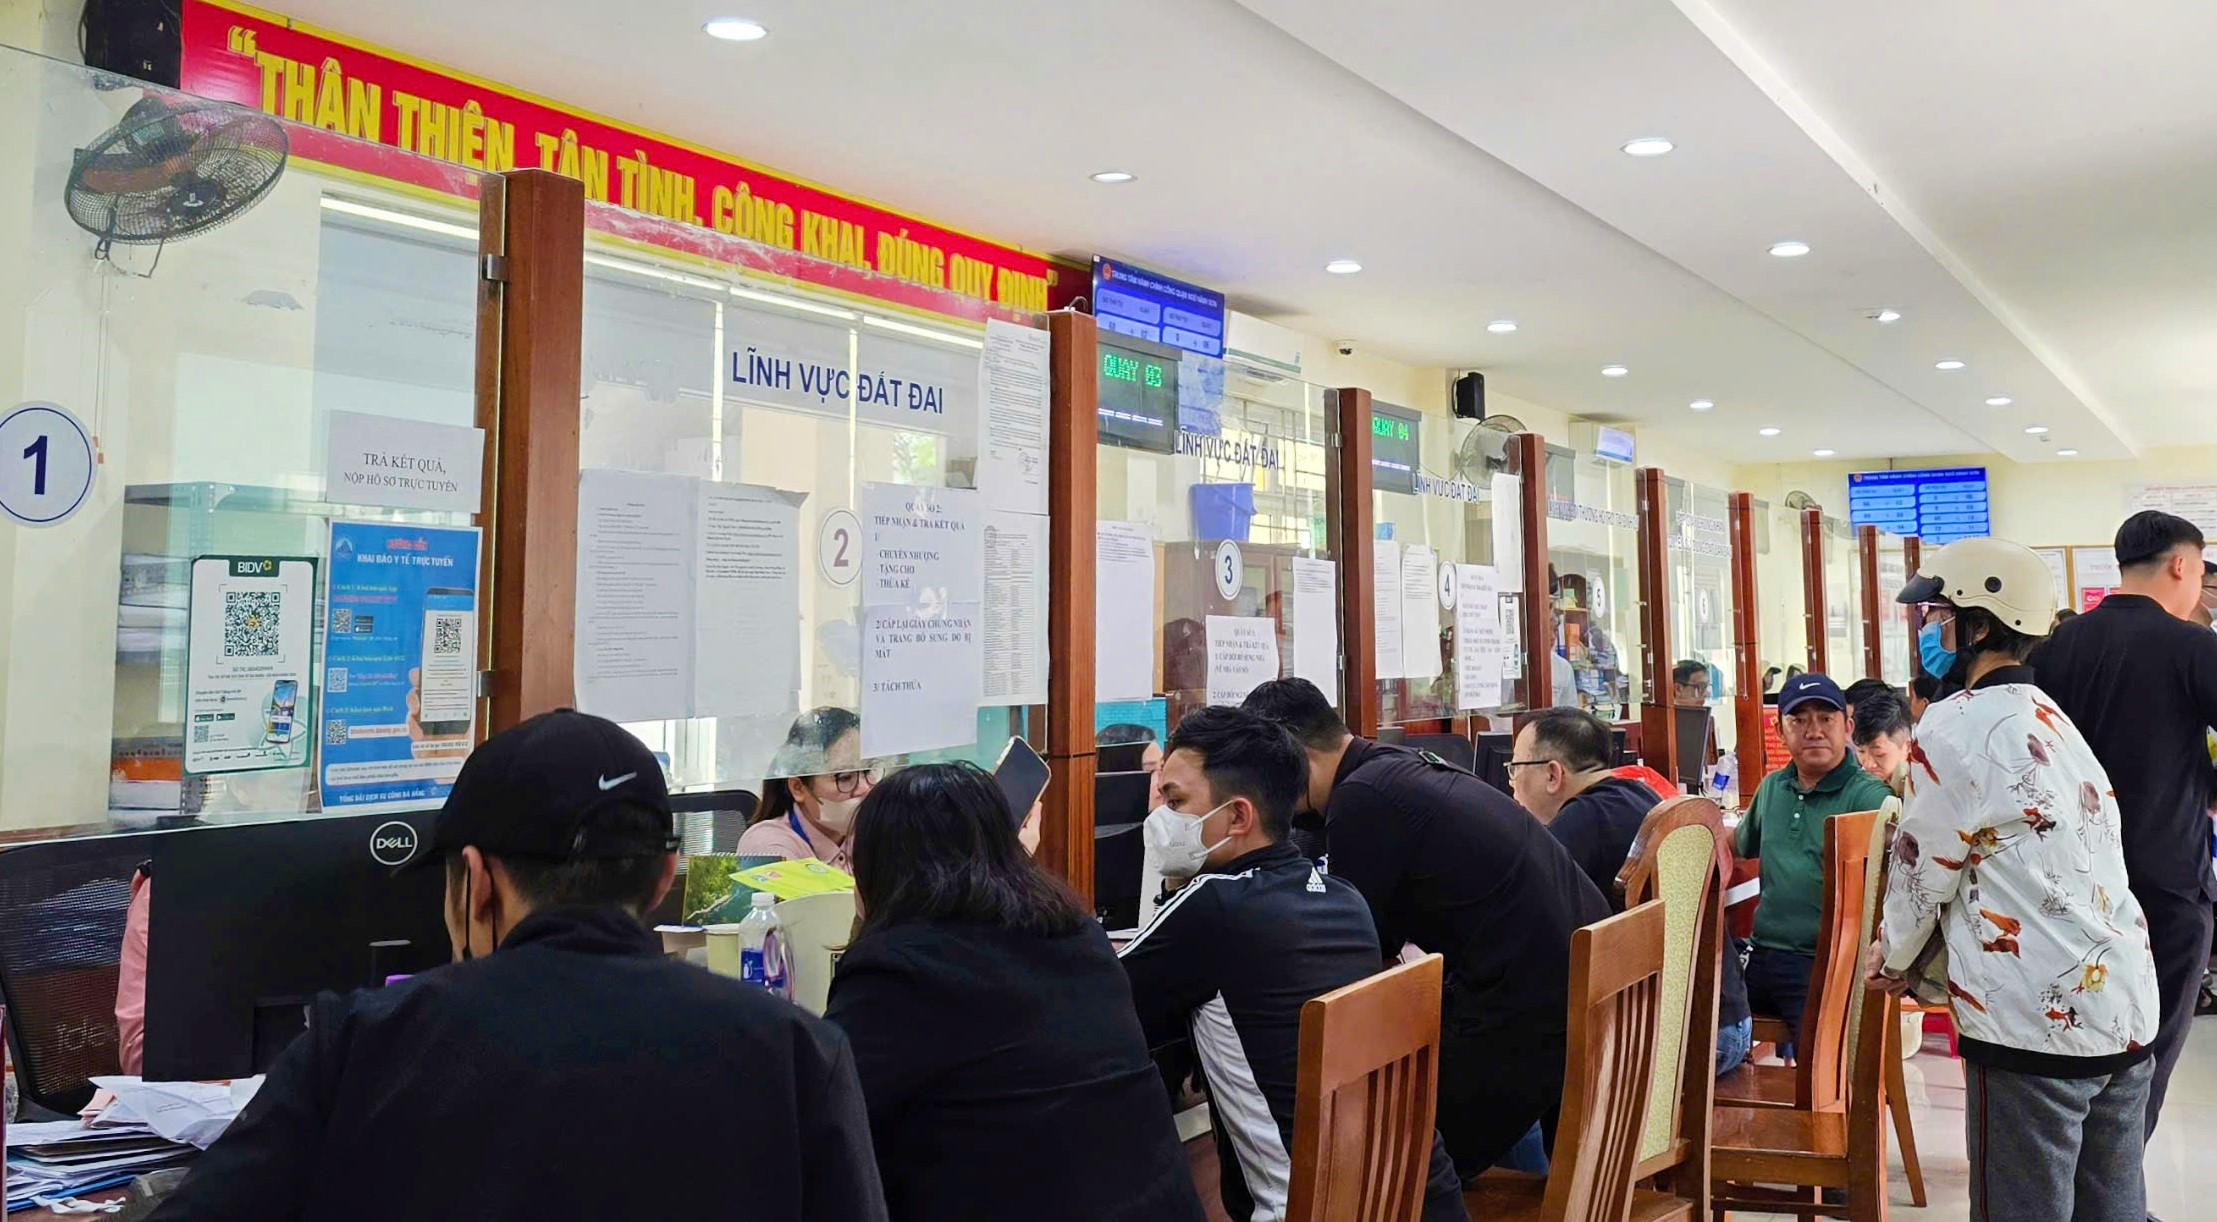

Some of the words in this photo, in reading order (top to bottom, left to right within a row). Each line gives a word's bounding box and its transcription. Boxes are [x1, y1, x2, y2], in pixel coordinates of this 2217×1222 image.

[712, 181, 795, 250] CÔNG
[878, 228, 945, 289] ĐÚNG
[951, 253, 994, 304] QUY
[732, 347, 791, 390] LĨNH
[798, 362, 850, 404] VỰC
[857, 371, 902, 407] ĐẤT
[908, 382, 943, 414] ĐAI
[1145, 364, 1162, 388] 03
[1174, 427, 1202, 458] LĨNH
[1261, 447, 1279, 471] ĐAI
[23, 435, 48, 496] 1
[363, 451, 388, 467] TRẢ
[391, 453, 415, 470] KẾT
[417, 457, 446, 475] QUẢ,
[344, 472, 365, 485] NỘP
[366, 472, 382, 486] HỒ
[397, 477, 425, 491] TRỰC
[425, 479, 458, 492] TUYẾN
[357, 553, 375, 563] KHAI
[393, 555, 400, 564] Y
[833, 528, 849, 568] 2
[237, 561, 264, 574] BIDV
[1224, 555, 1233, 584] 3
[1444, 574, 1451, 598] 4
[376, 838, 412, 849] DELL
